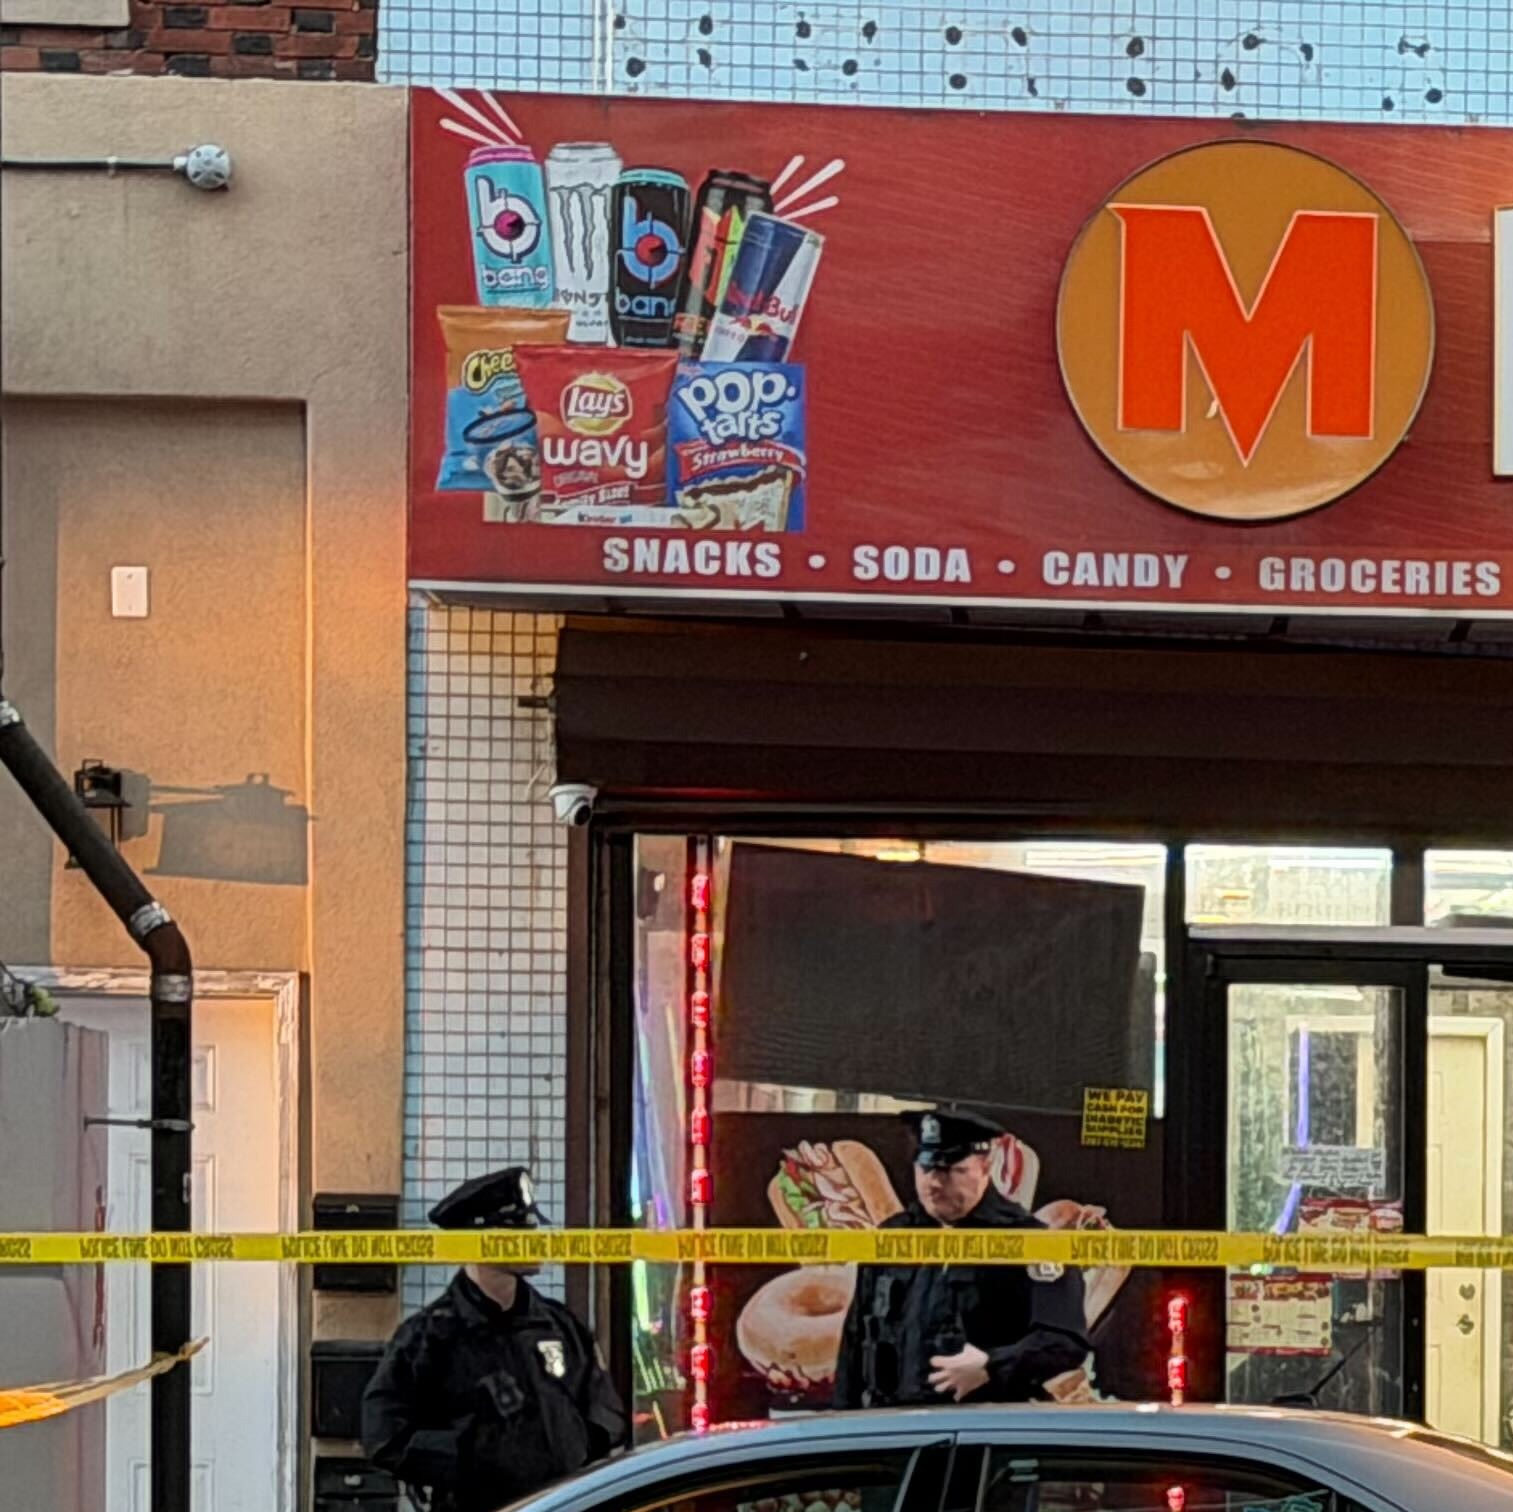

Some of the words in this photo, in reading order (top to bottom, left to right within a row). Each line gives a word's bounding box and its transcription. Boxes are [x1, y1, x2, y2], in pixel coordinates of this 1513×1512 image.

[615, 286, 676, 317] ban
[1106, 203, 1379, 467] M
[465, 349, 515, 391] Chee
[542, 436, 649, 480] wavy
[691, 443, 785, 472] Strawberry
[603, 537, 782, 578] SNACKS
[853, 545, 972, 583] SODA
[1042, 551, 1189, 590] CANDY
[1258, 557, 1501, 595] GROCERIES
